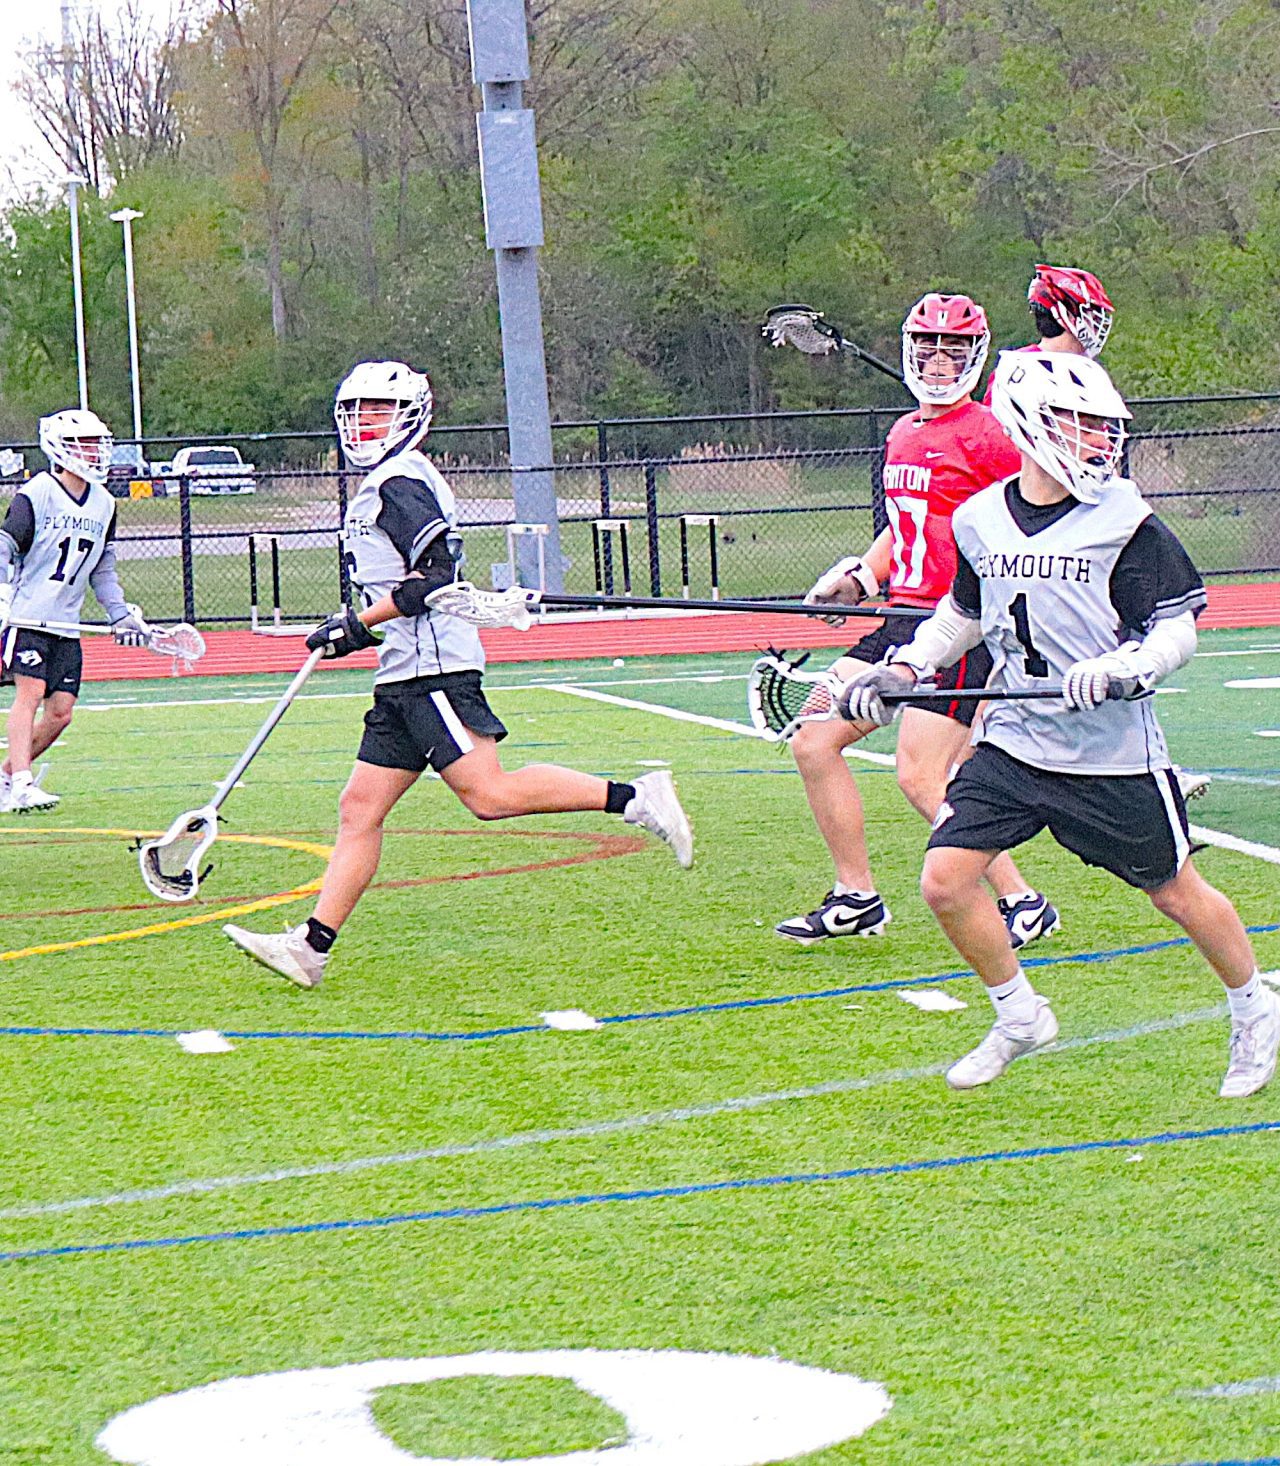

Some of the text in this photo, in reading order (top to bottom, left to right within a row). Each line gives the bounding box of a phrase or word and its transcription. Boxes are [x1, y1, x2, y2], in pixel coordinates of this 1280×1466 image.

[48, 536, 95, 586] 17
[884, 496, 929, 588] 17
[1008, 592, 1049, 678] 1
